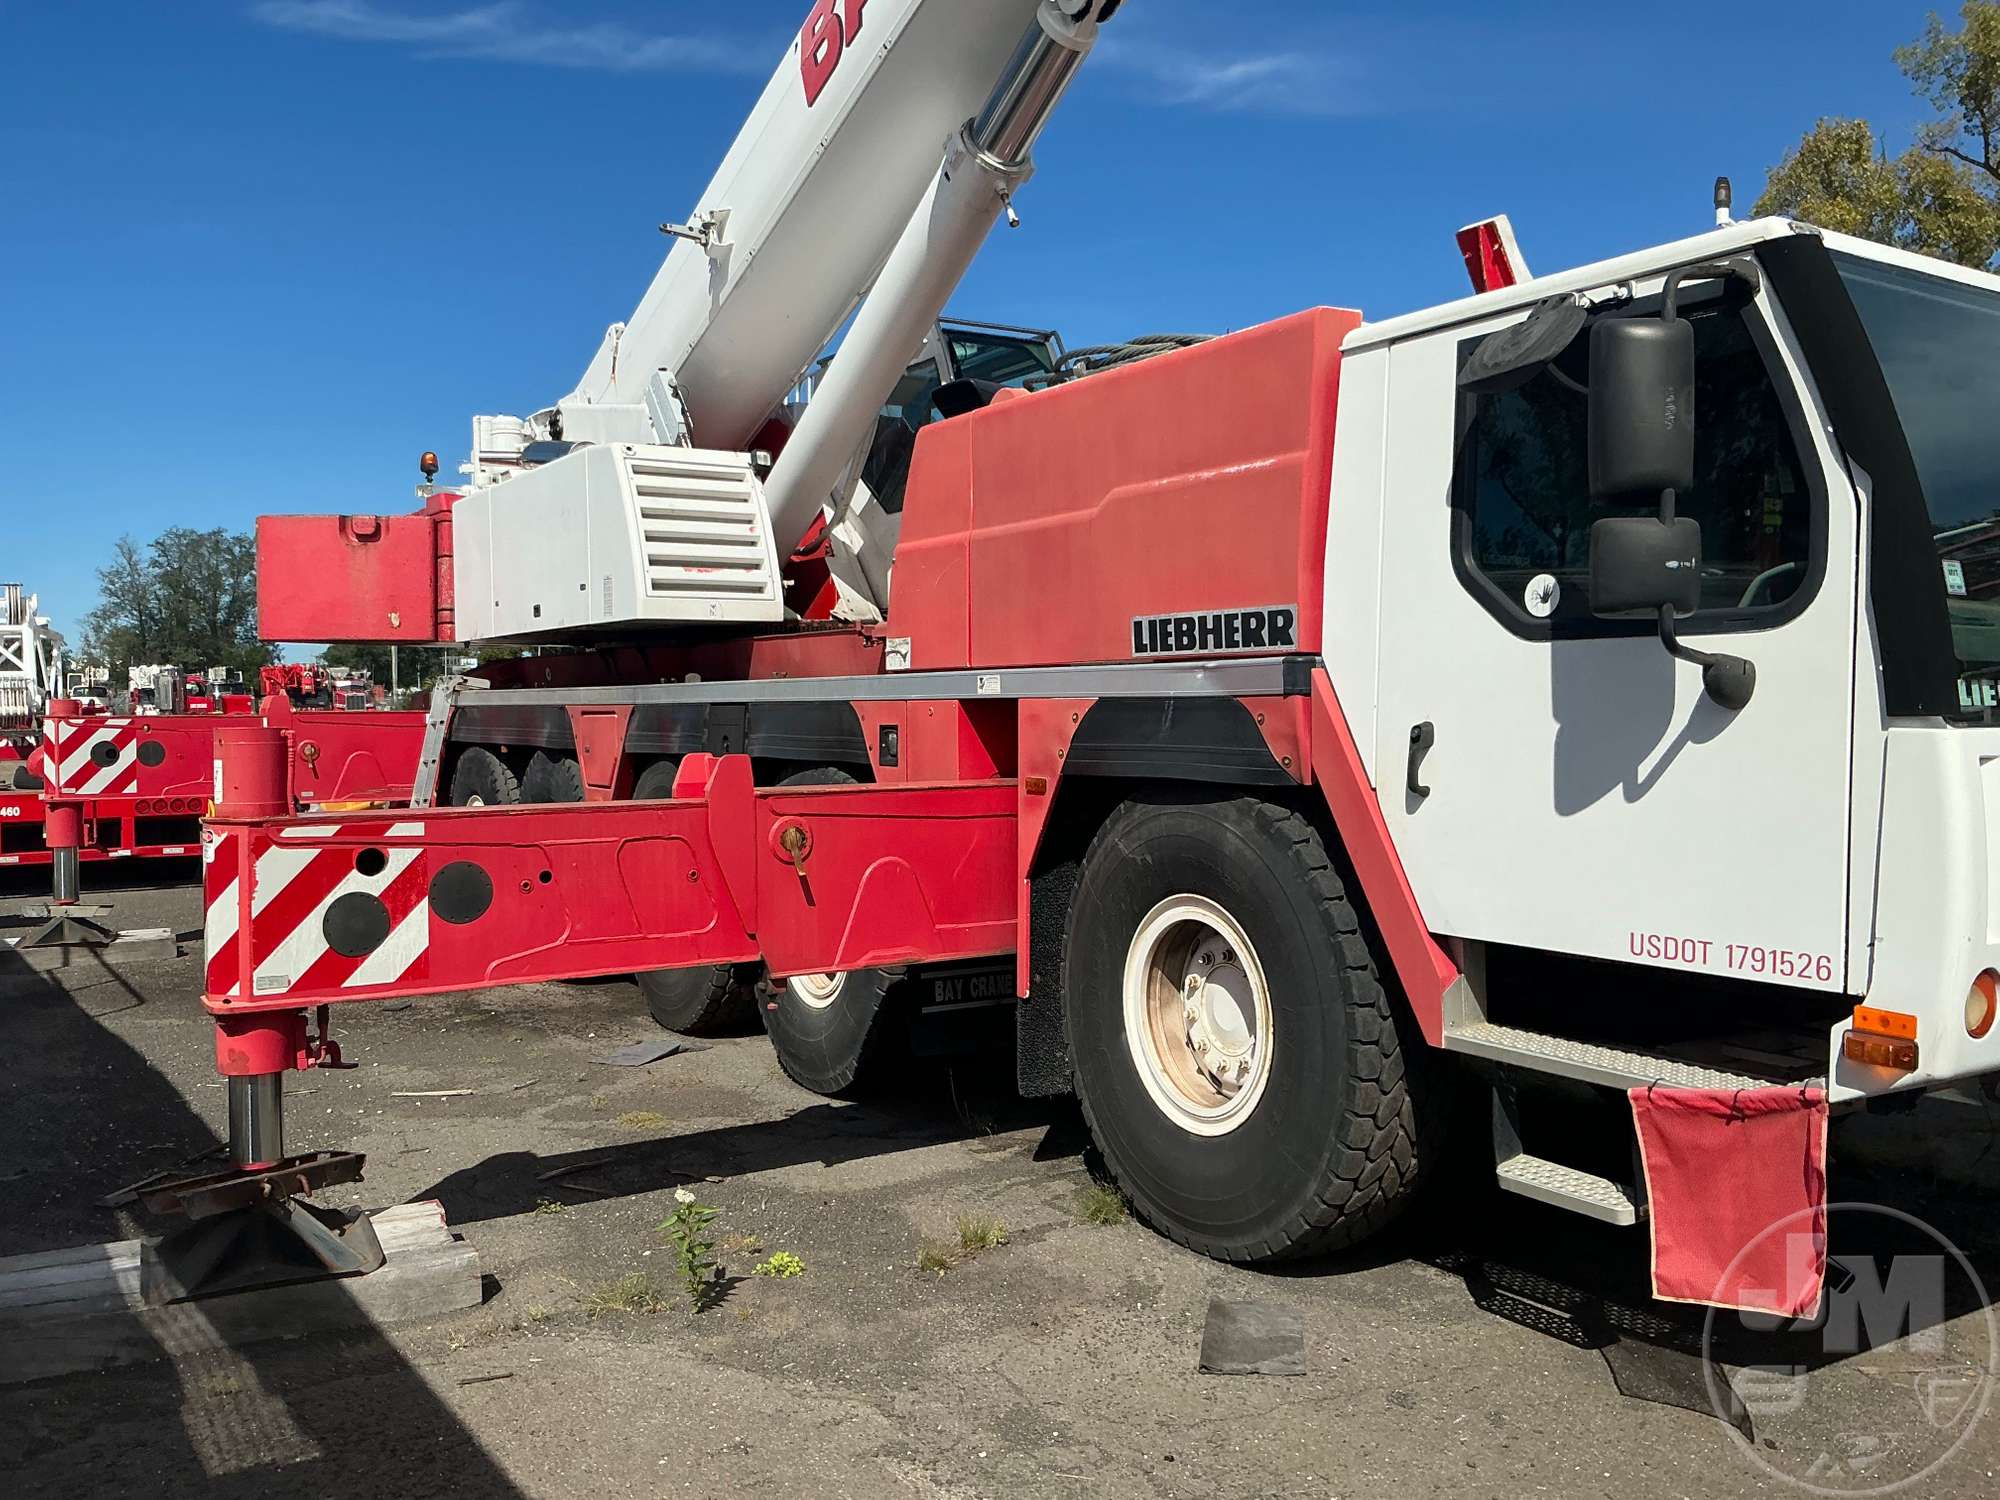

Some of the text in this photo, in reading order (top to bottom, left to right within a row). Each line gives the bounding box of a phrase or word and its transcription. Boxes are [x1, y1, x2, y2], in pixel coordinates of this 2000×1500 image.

[800, 0, 868, 108] B
[1133, 609, 1294, 653] LIEBHERR
[1957, 679, 2000, 706] LIE
[1630, 932, 1832, 982] USDOT 1791526
[935, 974, 1013, 1002] BAY CRANE
